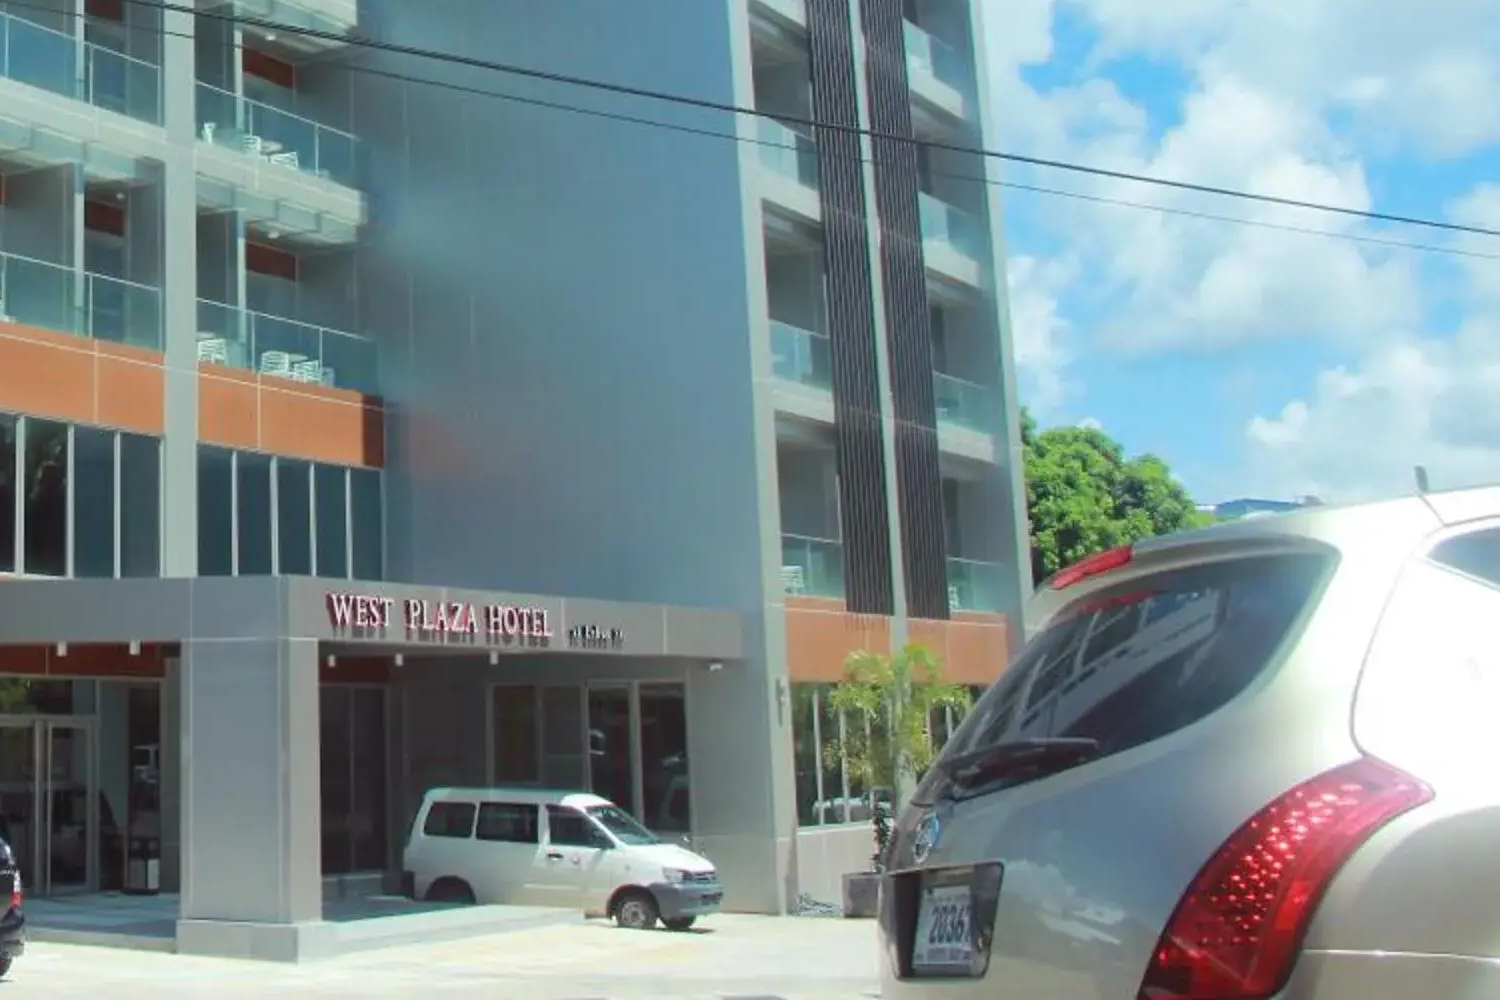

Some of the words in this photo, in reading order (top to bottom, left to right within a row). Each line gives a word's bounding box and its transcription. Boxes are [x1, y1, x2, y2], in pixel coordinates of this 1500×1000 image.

[327, 593, 394, 628] WEST
[405, 599, 479, 633] PLAZA
[485, 604, 553, 637] HOTEL
